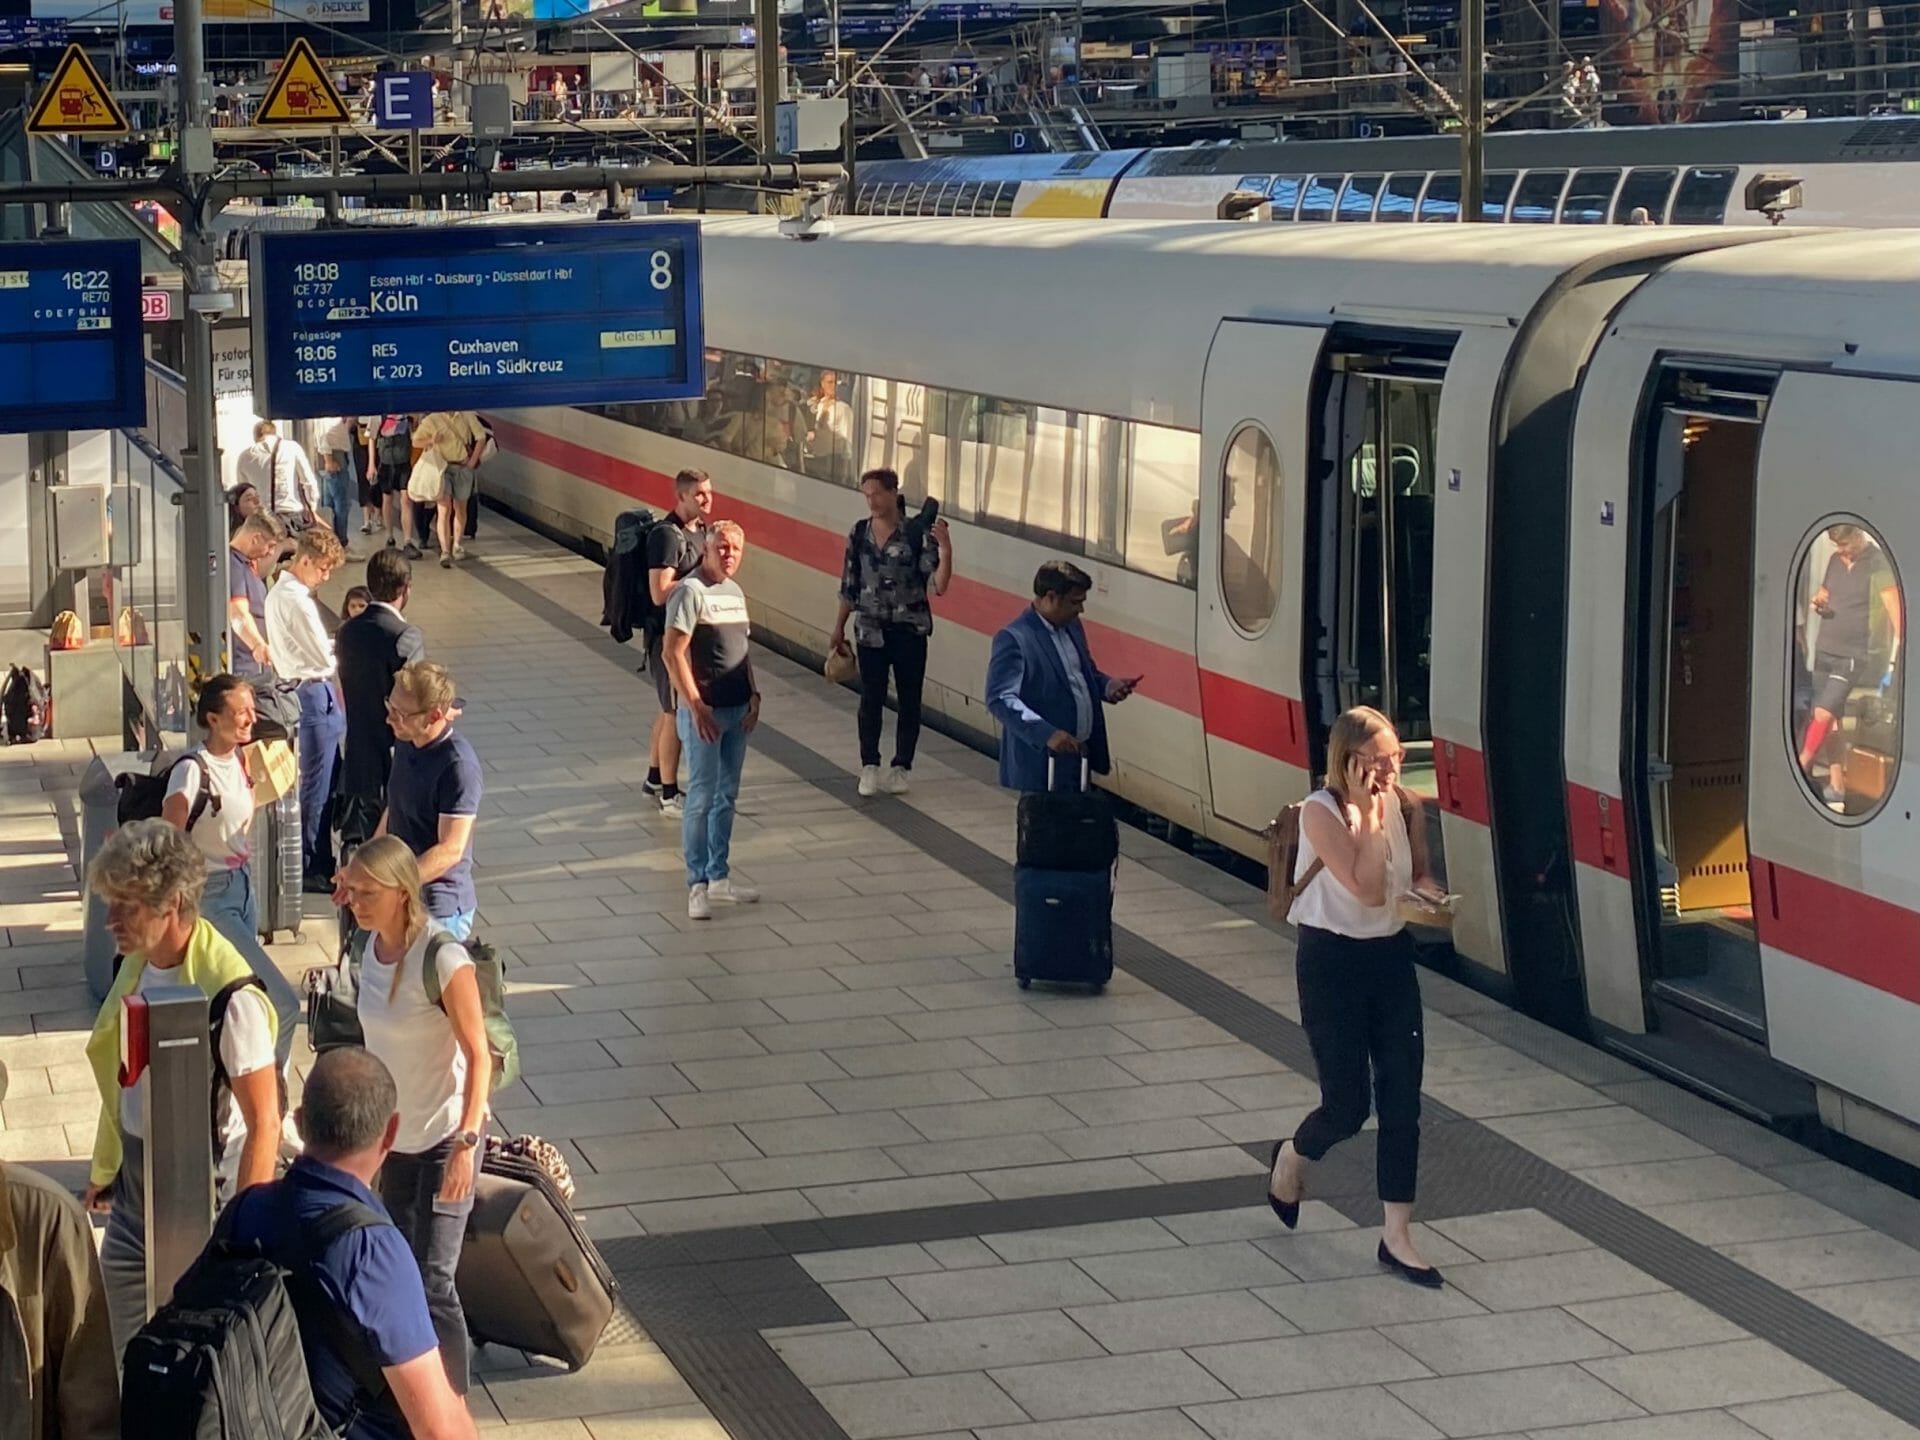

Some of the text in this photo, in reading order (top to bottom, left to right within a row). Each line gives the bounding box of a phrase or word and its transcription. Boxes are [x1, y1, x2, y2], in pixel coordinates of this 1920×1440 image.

[384, 78, 412, 120] E
[1361, 123, 1371, 137] D
[1014, 133, 1025, 148] D
[101, 152, 113, 167] D
[294, 263, 339, 281] 18:08
[370, 276, 402, 287] Essen
[405, 274, 423, 285] Hbf
[435, 273, 483, 286] Duisburg
[493, 270, 551, 282] Düsseldorf
[555, 268, 573, 278] Hbf
[650, 250, 672, 290] 8
[62, 270, 109, 290] 18:22
[293, 283, 333, 295] ICE 737
[82, 291, 110, 303] RE70
[370, 291, 418, 312] Köln
[295, 346, 337, 361] 18:06
[372, 344, 397, 357] RE5
[449, 339, 518, 354] Cuxhaven
[218, 368, 234, 381] Für
[373, 365, 422, 379] IC 2073
[450, 358, 563, 376] Berlin Südkreuz
[296, 367, 336, 383] 18:51
